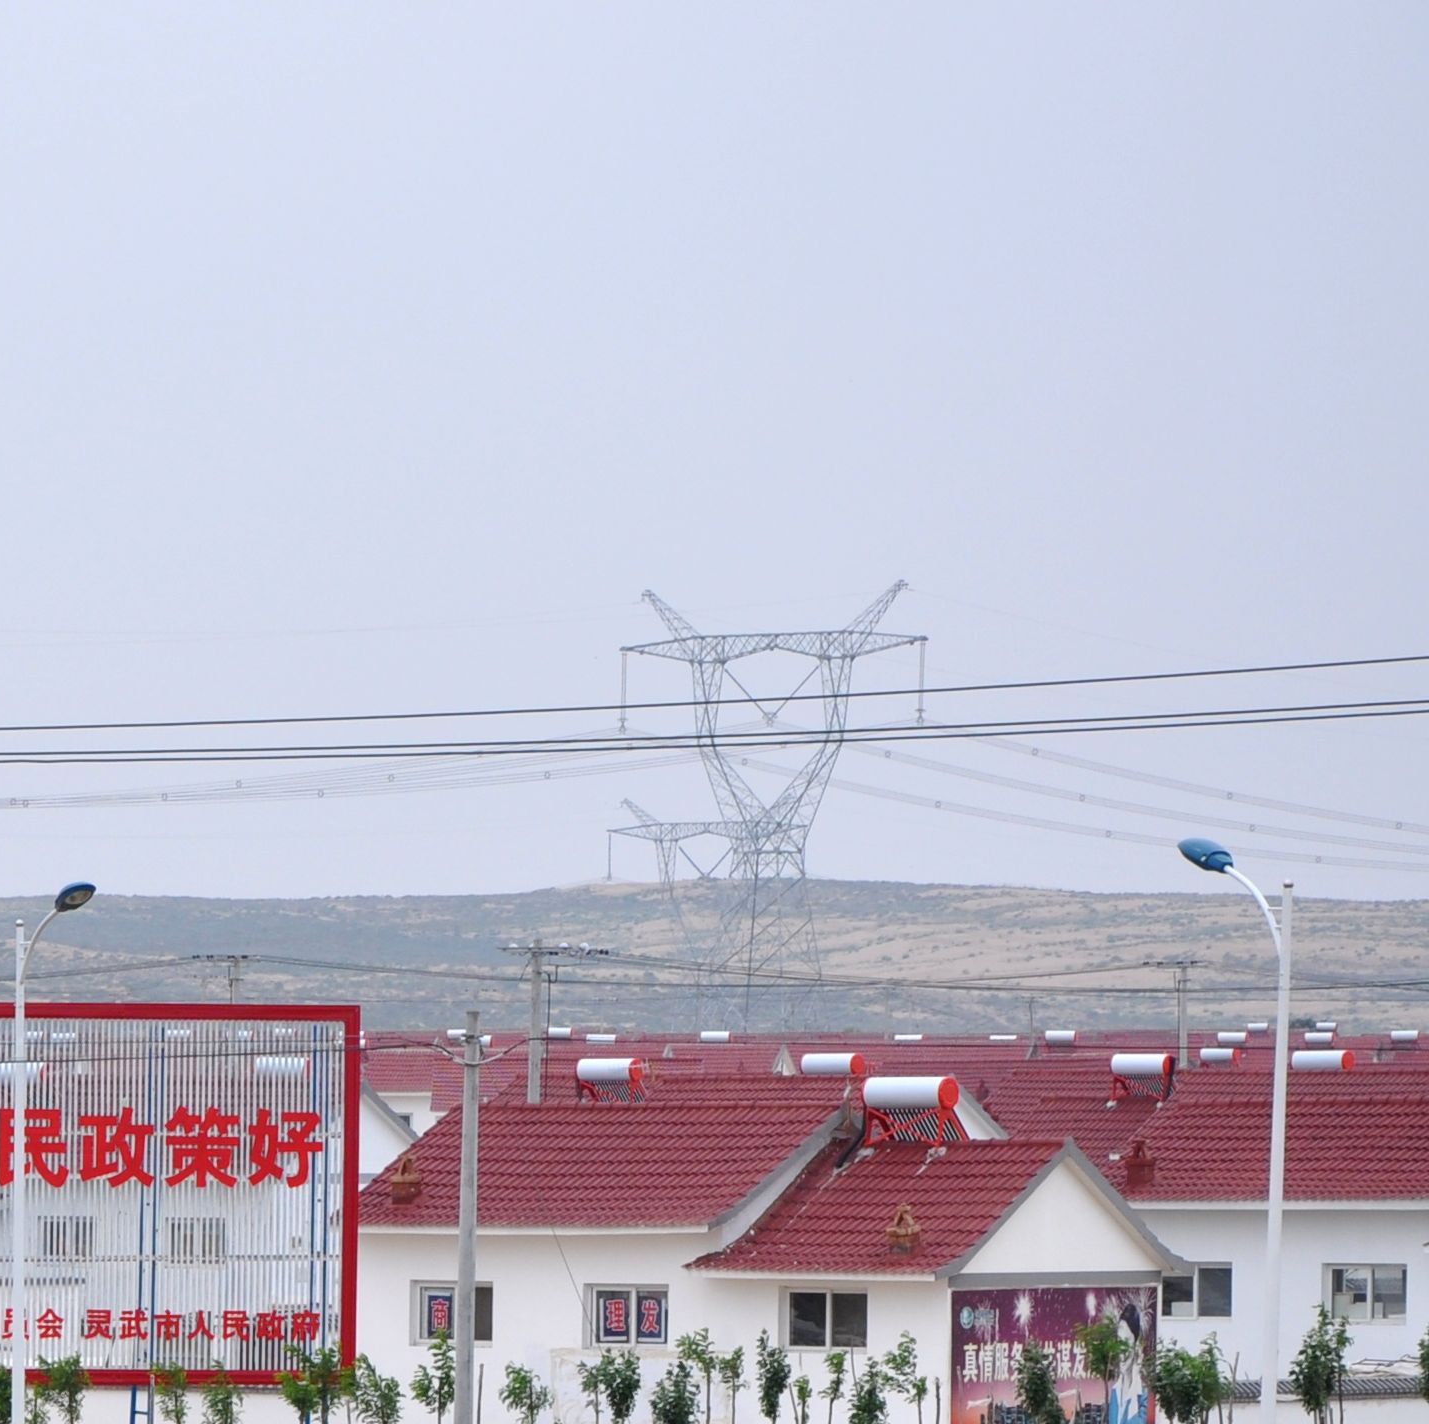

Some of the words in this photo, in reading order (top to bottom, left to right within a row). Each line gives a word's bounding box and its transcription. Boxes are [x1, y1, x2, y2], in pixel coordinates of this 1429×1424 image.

[84, 1308, 321, 1341] 灵武市人民政府
